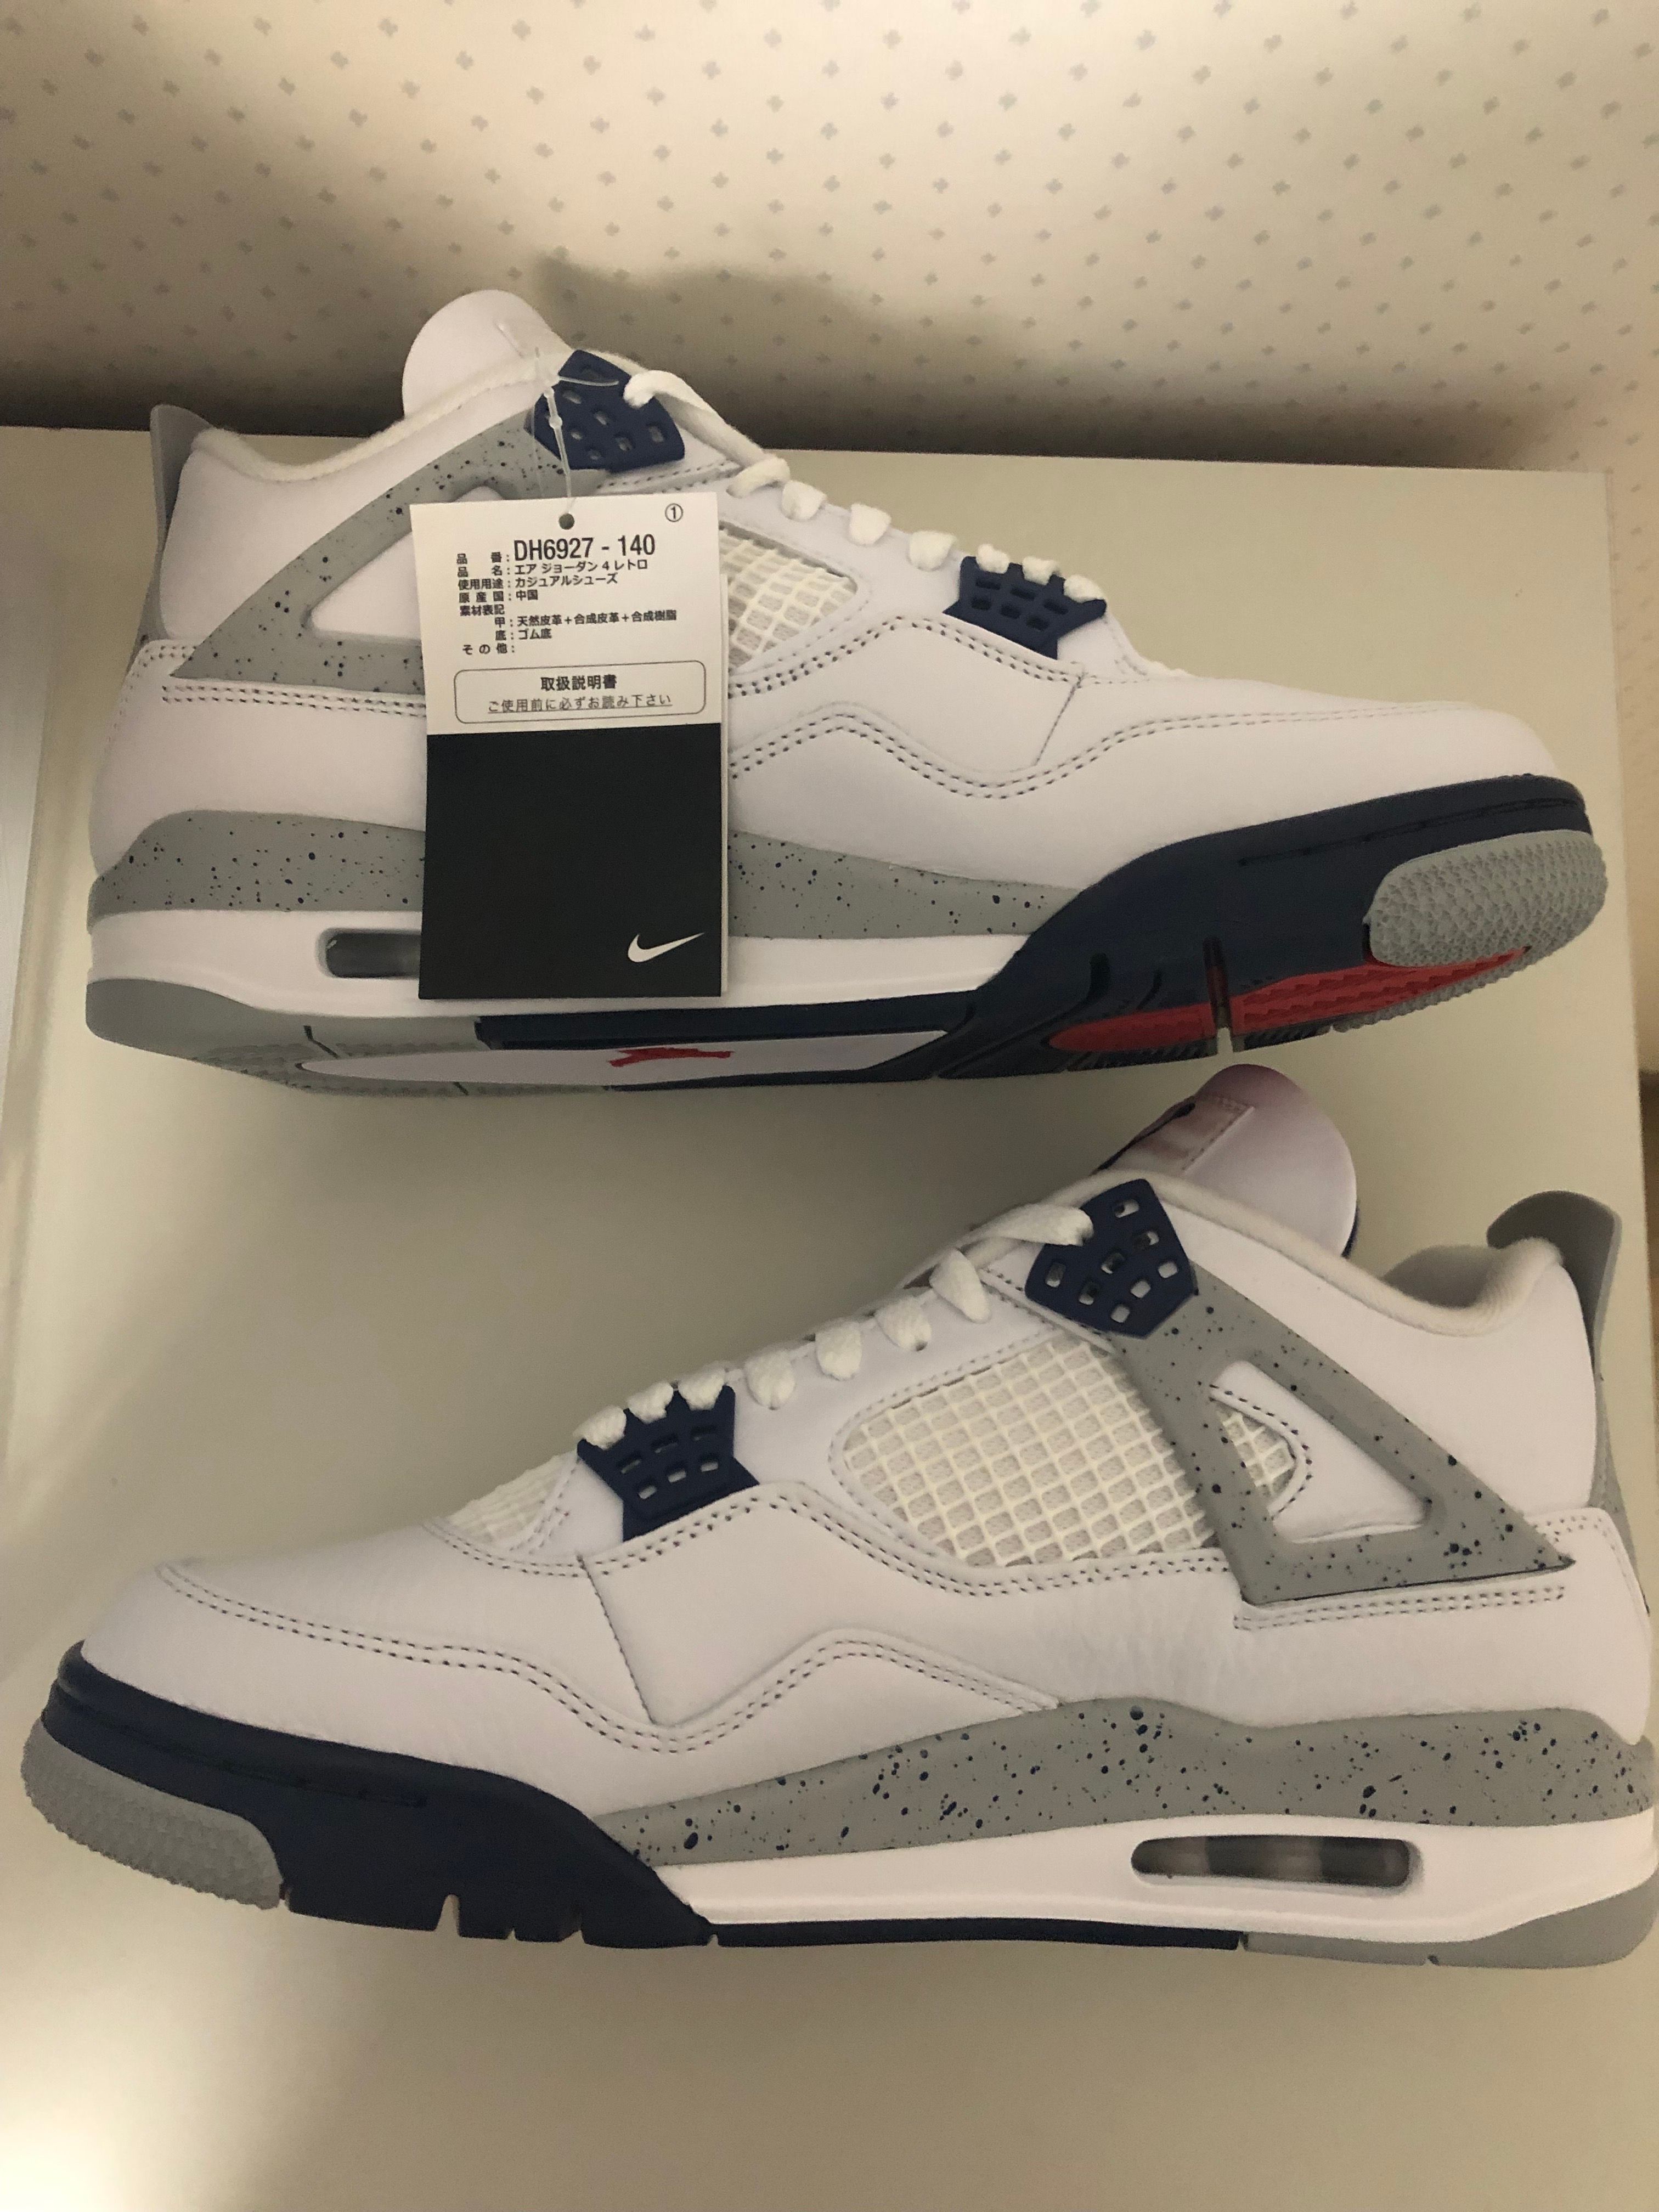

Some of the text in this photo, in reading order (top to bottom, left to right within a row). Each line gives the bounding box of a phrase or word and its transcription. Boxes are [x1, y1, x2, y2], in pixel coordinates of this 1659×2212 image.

[514, 537, 594, 561] DH6927
[618, 533, 656, 556] 140
[515, 572, 618, 588] カジュアルシューズ
[516, 589, 538, 601] 中国
[460, 604, 505, 616] 素材表記
[518, 628, 552, 640] ゴム底
[540, 674, 617, 691] 取扱説明書
[488, 693, 671, 712] ご使用前に必ずお読み下さい
